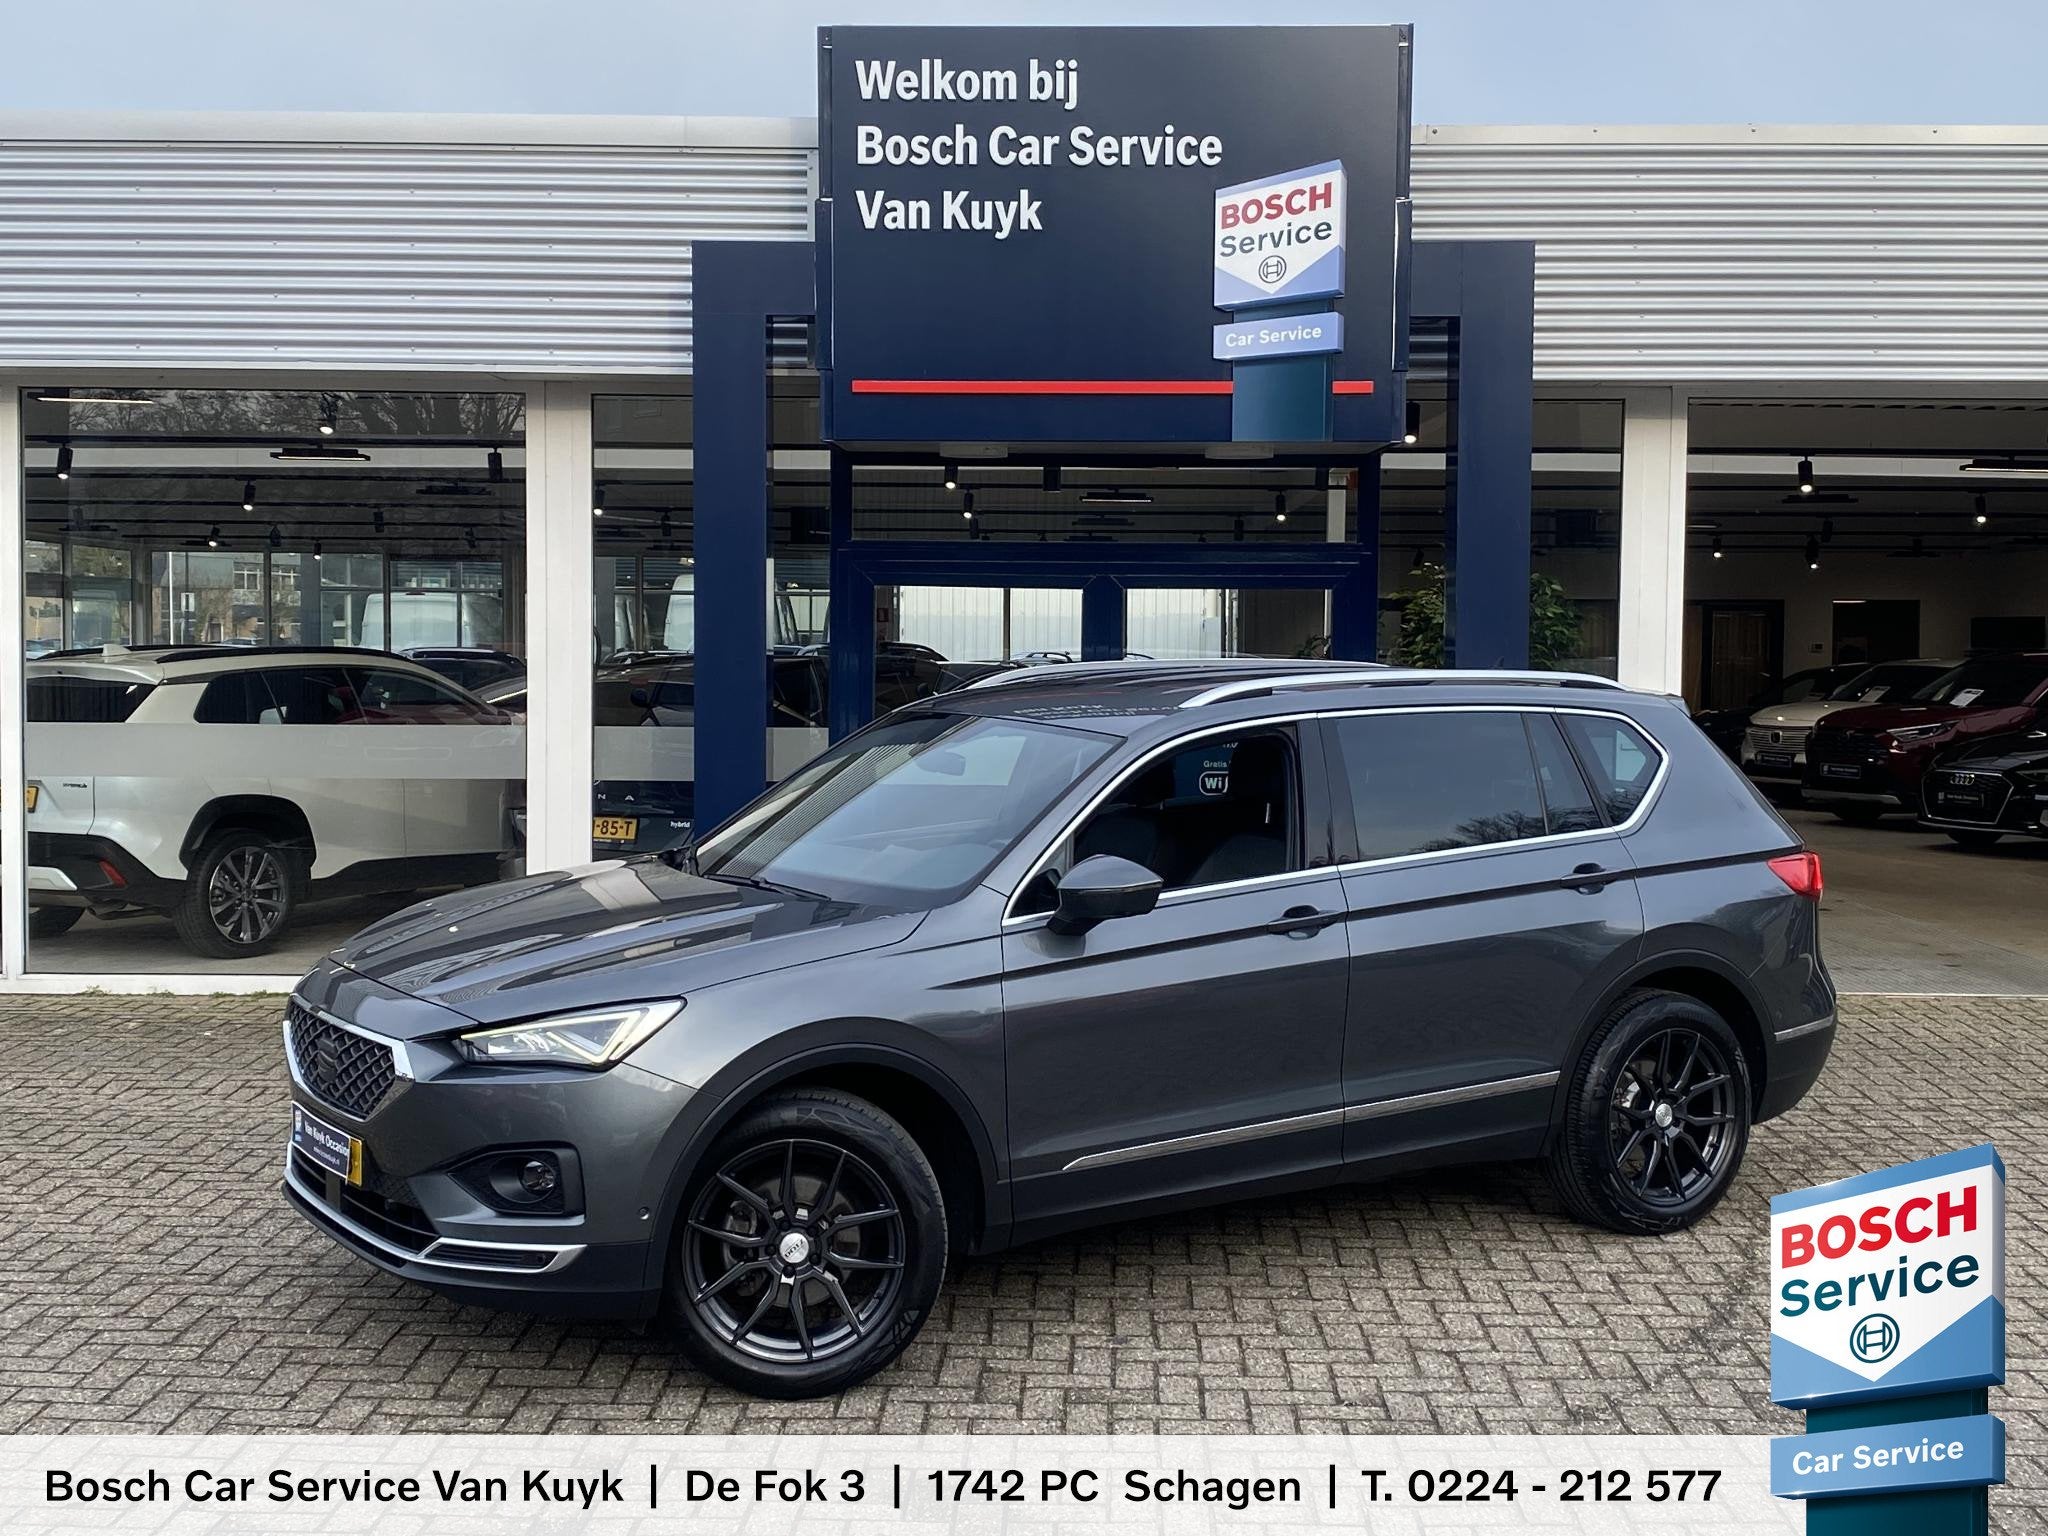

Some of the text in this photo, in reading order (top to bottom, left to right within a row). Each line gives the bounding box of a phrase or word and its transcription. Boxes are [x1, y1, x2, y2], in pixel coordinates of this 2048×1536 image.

[855, 59, 1078, 109] Welkom bij
[857, 124, 1223, 166] Bosch Car Service
[856, 189, 1043, 239] Van Kuyk
[1221, 182, 1333, 229] BOSCH
[1220, 221, 1332, 258] Service
[1225, 325, 1322, 348] Car Service
[670, 821, 690, 829] hybrid
